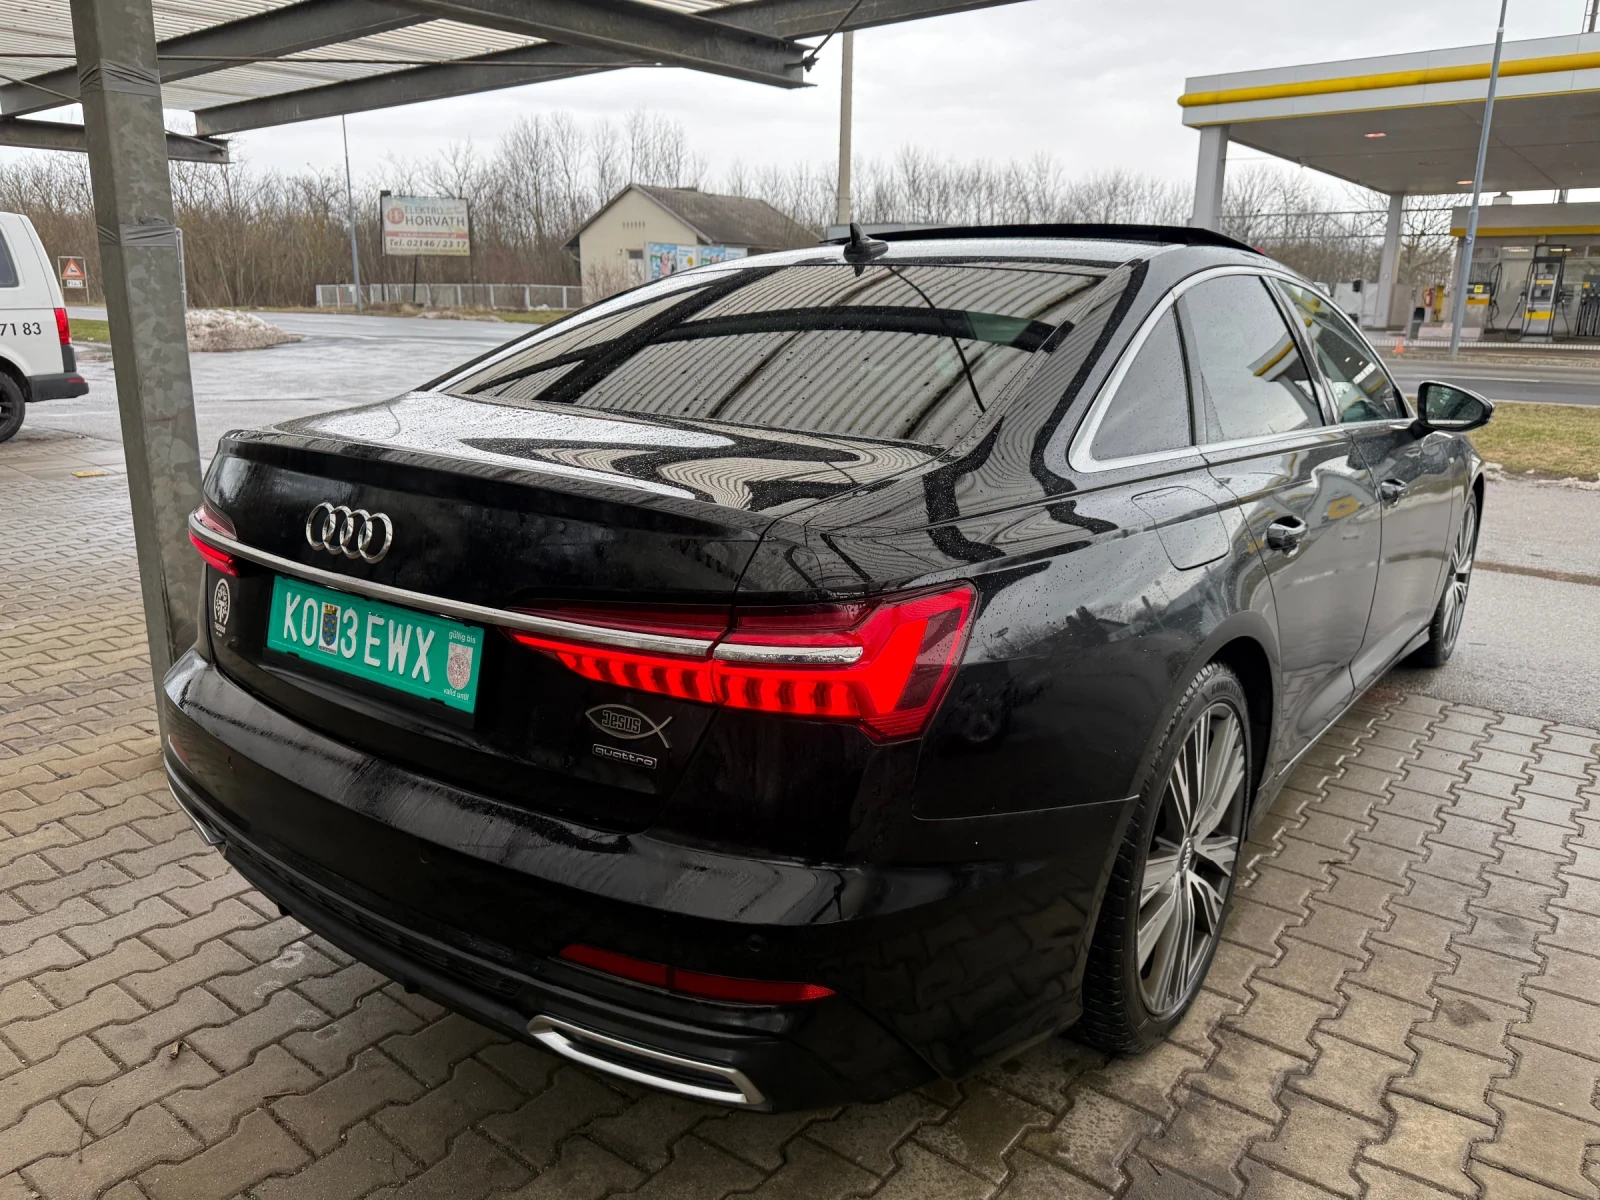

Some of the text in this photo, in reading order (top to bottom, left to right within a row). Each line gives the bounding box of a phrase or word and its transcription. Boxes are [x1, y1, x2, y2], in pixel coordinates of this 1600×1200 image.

[404, 205, 444, 215] ELEKTRO
[405, 215, 465, 227] HORVATH
[389, 239, 405, 247] Tel.
[22, 322, 42, 336] 83
[283, 592, 319, 646] KO
[448, 630, 476, 644] gültig bis
[443, 688, 469, 701] valid until
[595, 747, 654, 766] quattro
